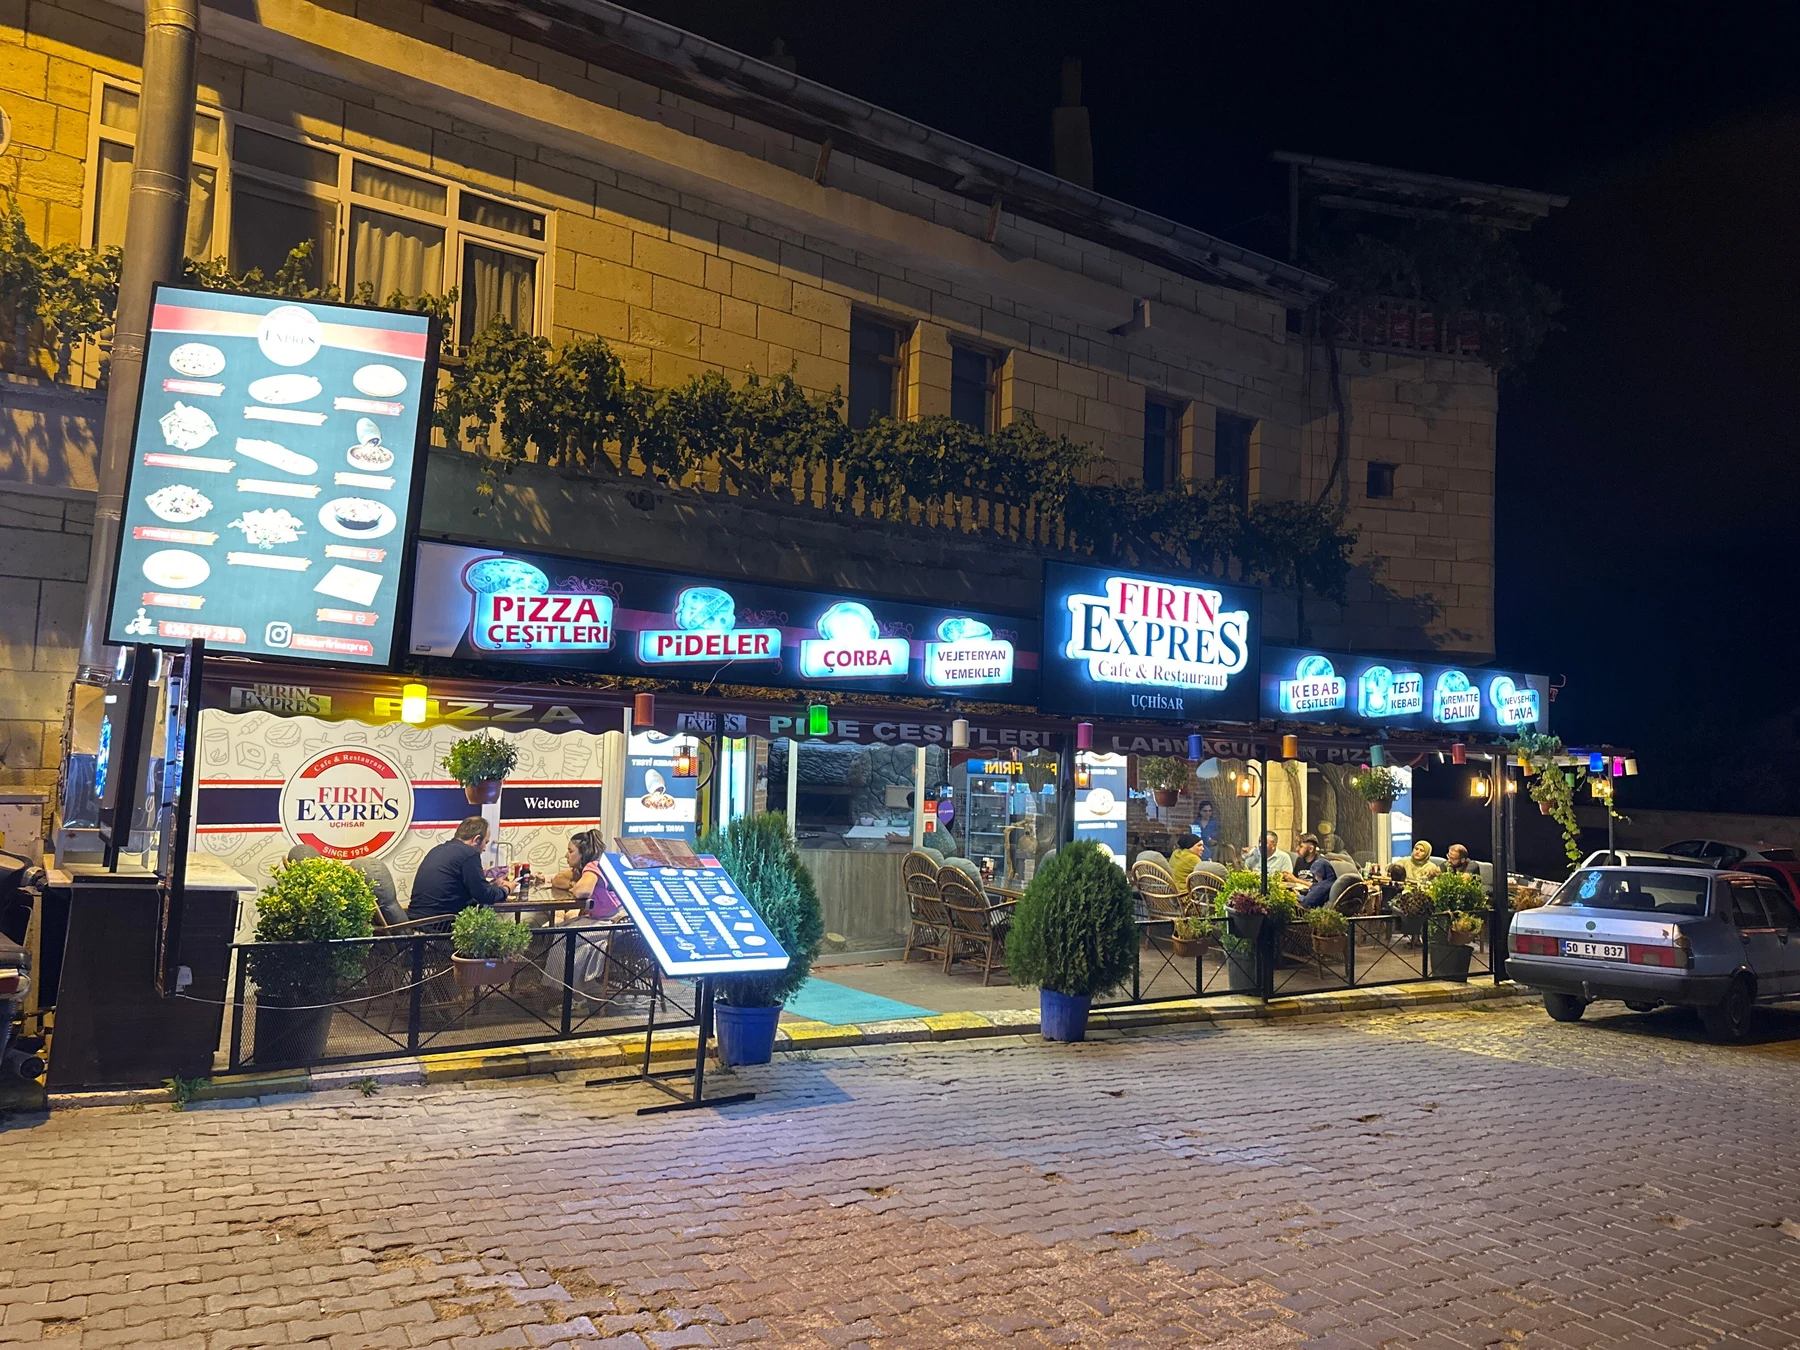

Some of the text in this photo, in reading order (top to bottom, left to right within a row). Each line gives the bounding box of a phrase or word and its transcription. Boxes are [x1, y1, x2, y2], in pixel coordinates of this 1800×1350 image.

[1118, 581, 1218, 625] FIRIN
[1077, 602, 1242, 668] EXPRES
[823, 649, 893, 673] ÇORBA
[937, 650, 1007, 662] VEJETERYAN
[944, 667, 1001, 680] YEMEKLER
[1098, 660, 1225, 687] Cafe & Restaurant
[256, 684, 310, 699] FIRIN
[1291, 682, 1340, 699] KEBAB
[239, 690, 322, 714] EXPRES
[1390, 697, 1420, 709] KEBABI
[1443, 705, 1475, 720] BALIK
[1508, 707, 1534, 720] TAVA
[684, 714, 740, 732] EXPES
[313, 754, 387, 772] Cafe & Restaurant
[317, 786, 386, 804] FIRIN
[523, 796, 580, 809] Welcome
[294, 797, 399, 822] EXPRES
[350, 845, 370, 857] 1976
[1566, 942, 1623, 957] 50 EY 837
